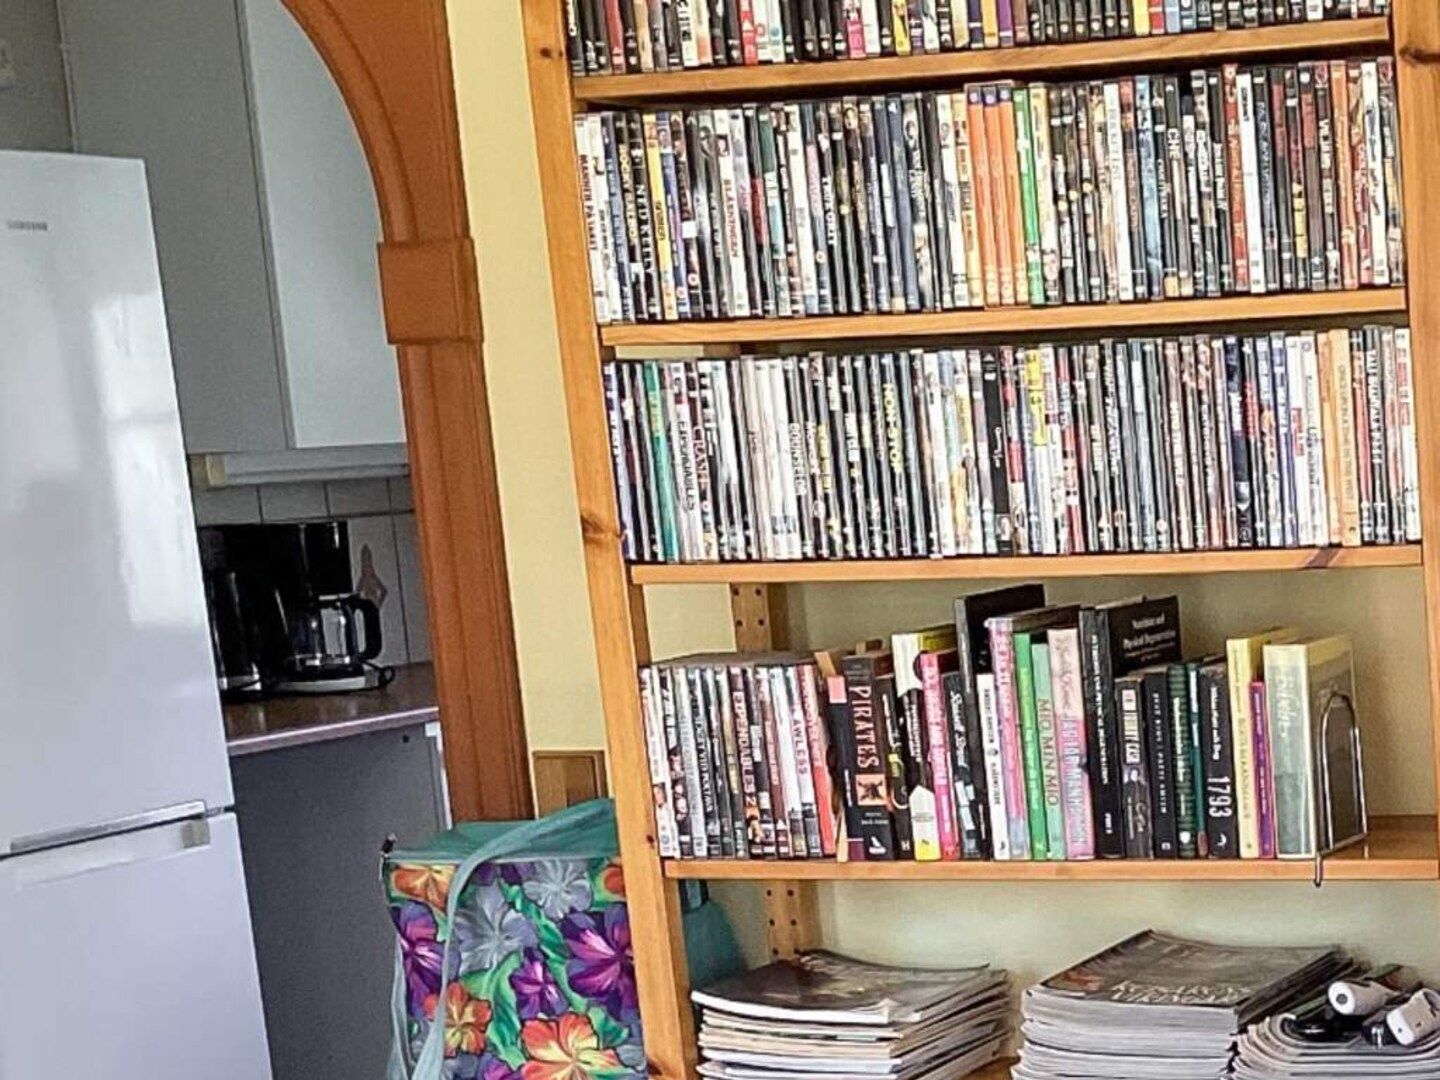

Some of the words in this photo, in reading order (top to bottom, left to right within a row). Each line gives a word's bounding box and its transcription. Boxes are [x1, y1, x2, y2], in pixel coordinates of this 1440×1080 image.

[1166, 128, 1181, 159] CHE
[618, 144, 630, 189] ROCKY
[635, 184, 649, 220] NED
[639, 225, 654, 274] KELLY
[825, 213, 837, 247] GRIT
[882, 383, 902, 474] NON-STOP
[691, 425, 710, 484] CRASH
[732, 691, 756, 793] EXPENDABLES
[849, 685, 879, 768] PIRATES
[1040, 737, 1055, 772] MIN
[1045, 774, 1059, 806] MIO
[1207, 775, 1233, 818] 1793
